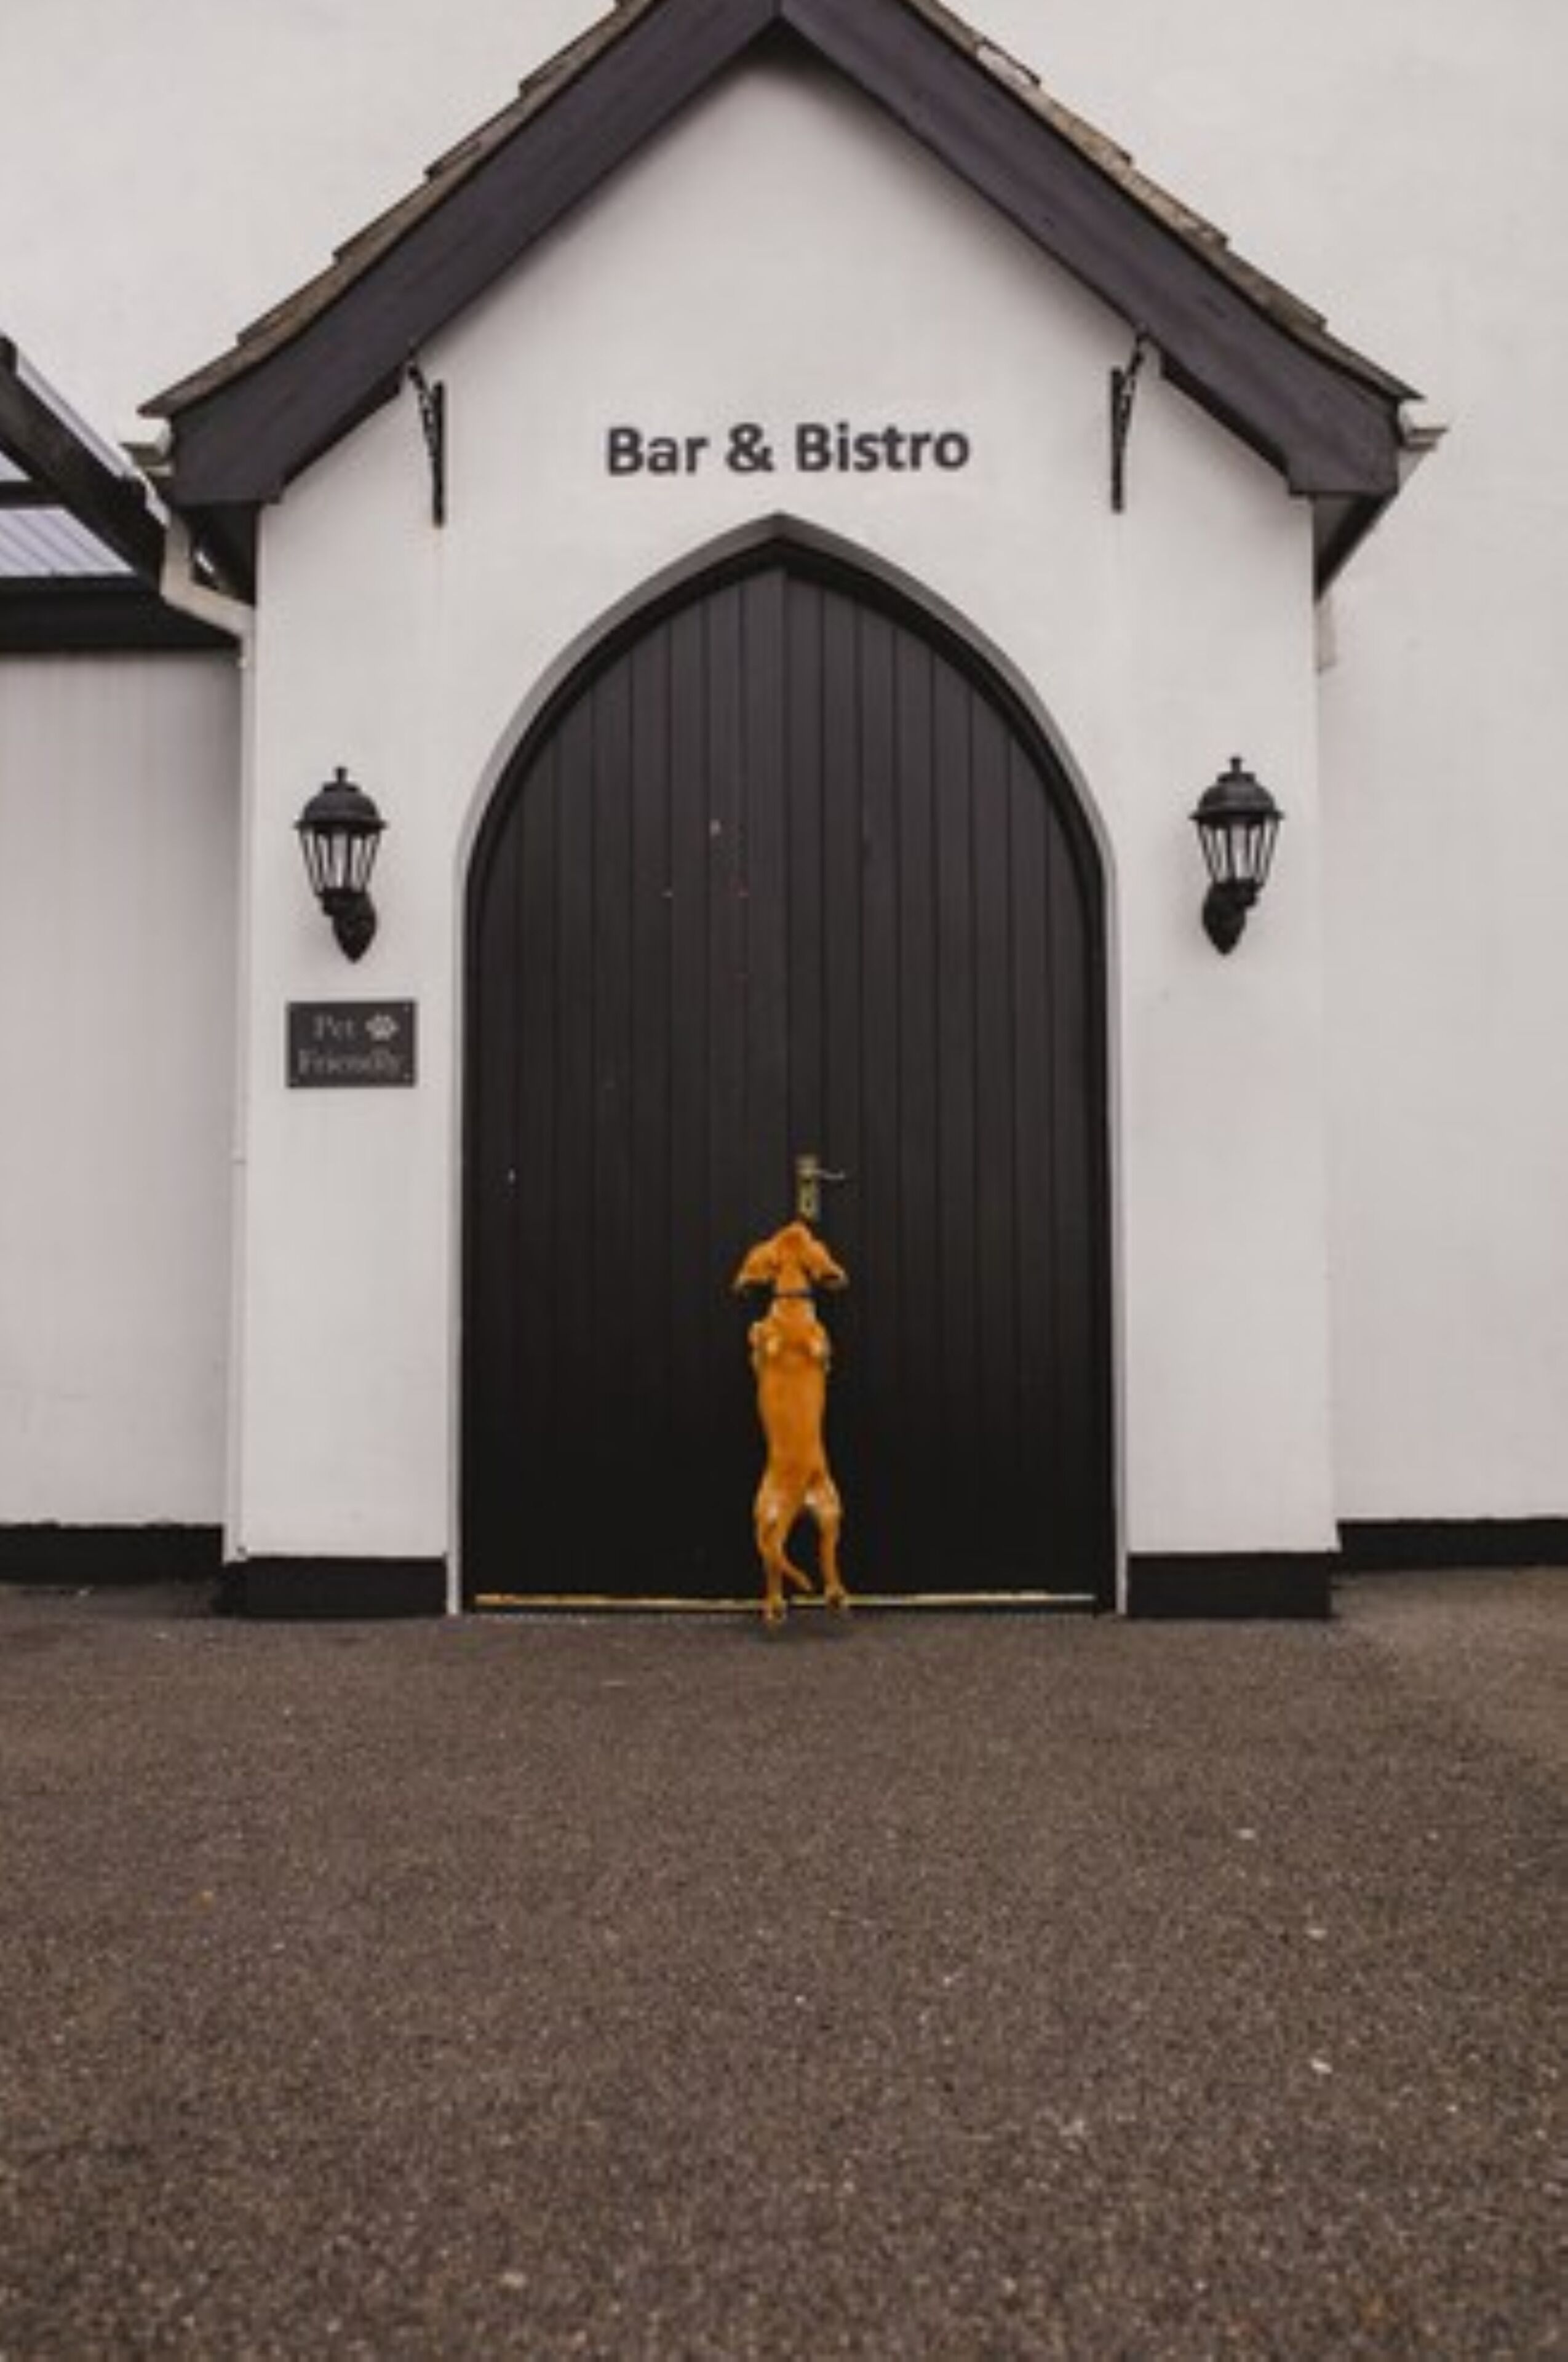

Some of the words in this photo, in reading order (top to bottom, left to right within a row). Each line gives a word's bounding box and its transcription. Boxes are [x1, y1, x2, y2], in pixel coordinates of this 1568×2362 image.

[607, 426, 710, 476] Bar
[725, 422, 775, 474] &
[795, 421, 971, 473] Bistro
[312, 1015, 357, 1041] Pet
